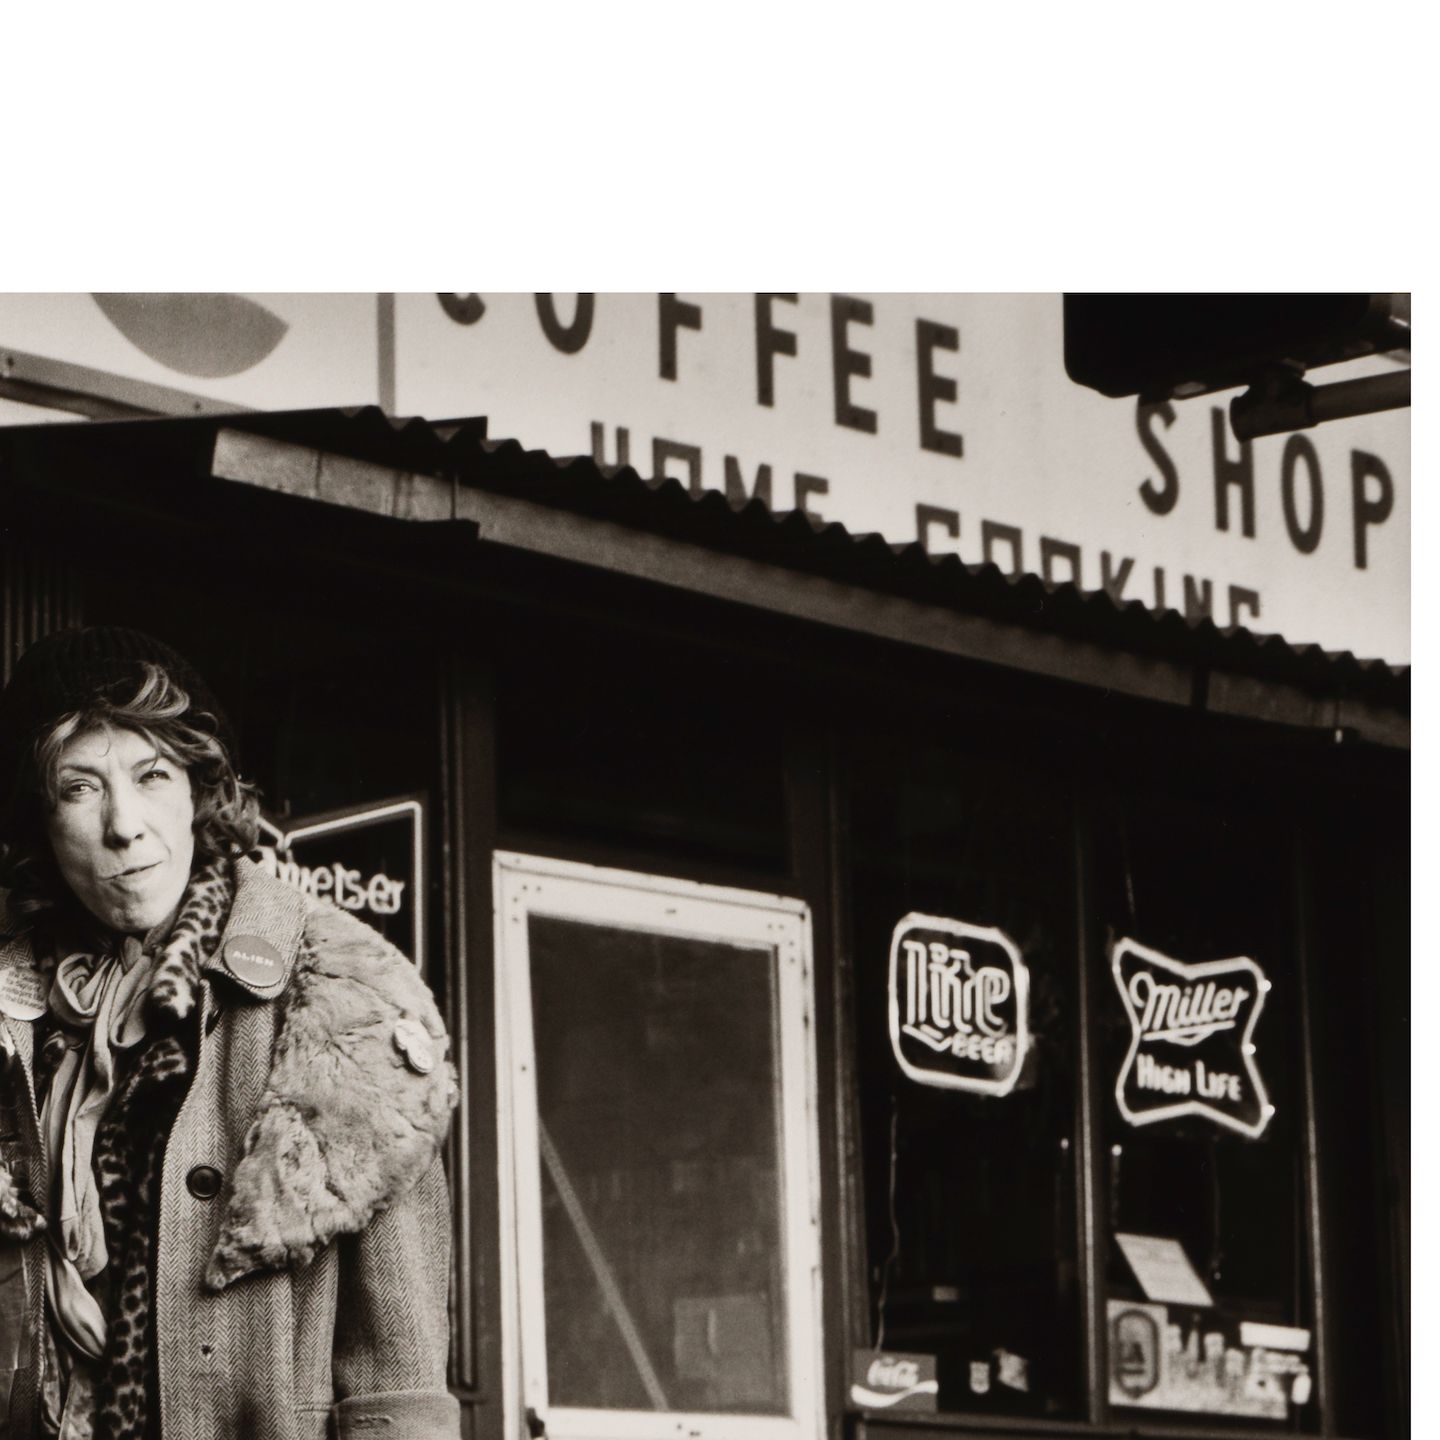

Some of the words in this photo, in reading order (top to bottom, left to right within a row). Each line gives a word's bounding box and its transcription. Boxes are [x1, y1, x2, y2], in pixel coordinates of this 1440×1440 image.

[436, 292, 964, 458] FFEE
[1136, 393, 1395, 570] SHOP
[1129, 971, 1250, 1031] Miller
